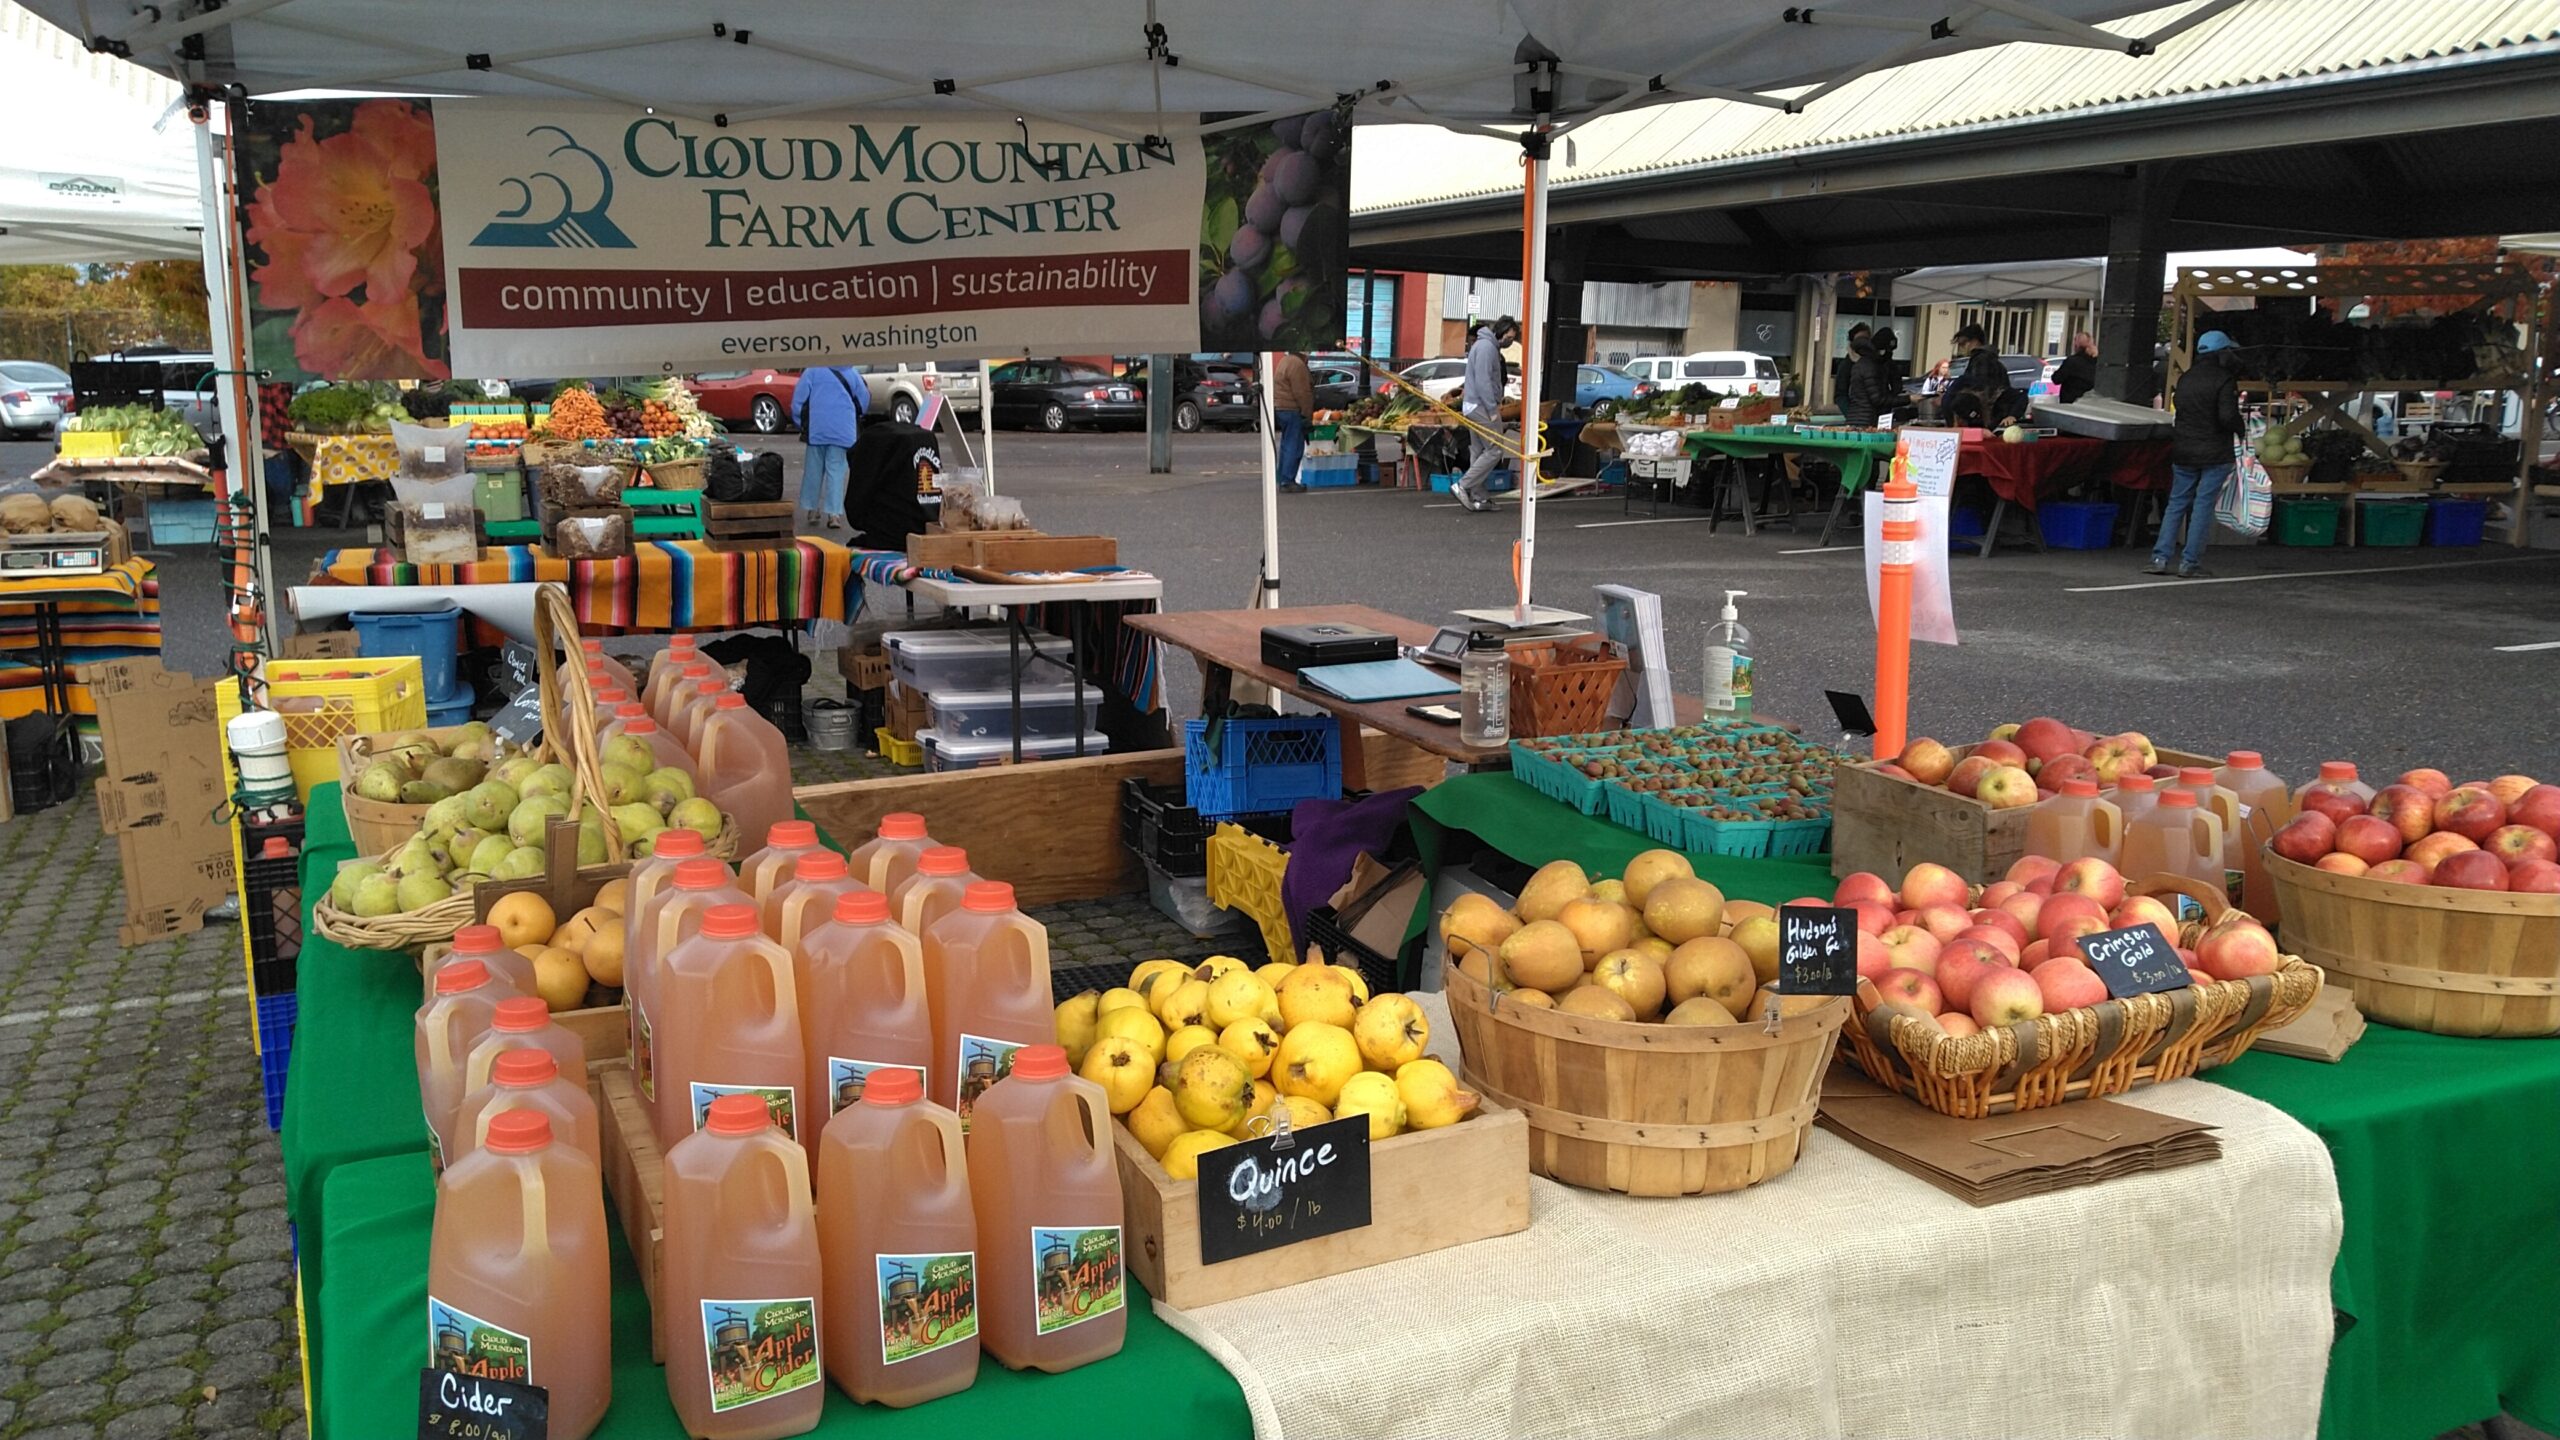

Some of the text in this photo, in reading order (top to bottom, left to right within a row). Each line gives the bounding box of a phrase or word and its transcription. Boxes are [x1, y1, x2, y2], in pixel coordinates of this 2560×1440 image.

[624, 118, 1175, 184] CLOUD MOUNTAIN
[702, 188, 1121, 248] FARM CENTER
[501, 278, 711, 316] community
[746, 270, 919, 307] education
[952, 258, 1158, 297] sustainability
[721, 323, 977, 354] everson, washington
[1787, 915, 1837, 943] Hudson's
[2088, 929, 2151, 961] Crimson
[2121, 943, 2154, 967] Gold
[766, 1098, 788, 1108] NTAIN
[1229, 1143, 1337, 1202] Quince
[1083, 1234, 1105, 1247] CLOUD
[1083, 1237, 1117, 1254] MOUNTAIN
[931, 1261, 957, 1274] CLOUD
[931, 1263, 970, 1281] MOUNTAIN
[1071, 1249, 1119, 1287] Apple
[922, 1275, 971, 1313] Apple
[1072, 1275, 1119, 1316] Cider
[764, 1306, 793, 1320] CLOUD
[764, 1309, 808, 1327] MOUNTAIN
[921, 1302, 972, 1345] Cider
[480, 1333, 507, 1344] CLOUD
[480, 1342, 523, 1354] MOUNTAIN
[753, 1321, 811, 1362] Apple
[469, 1355, 525, 1380] Apple
[754, 1348, 812, 1392] Cider
[441, 1373, 512, 1416] Cider
